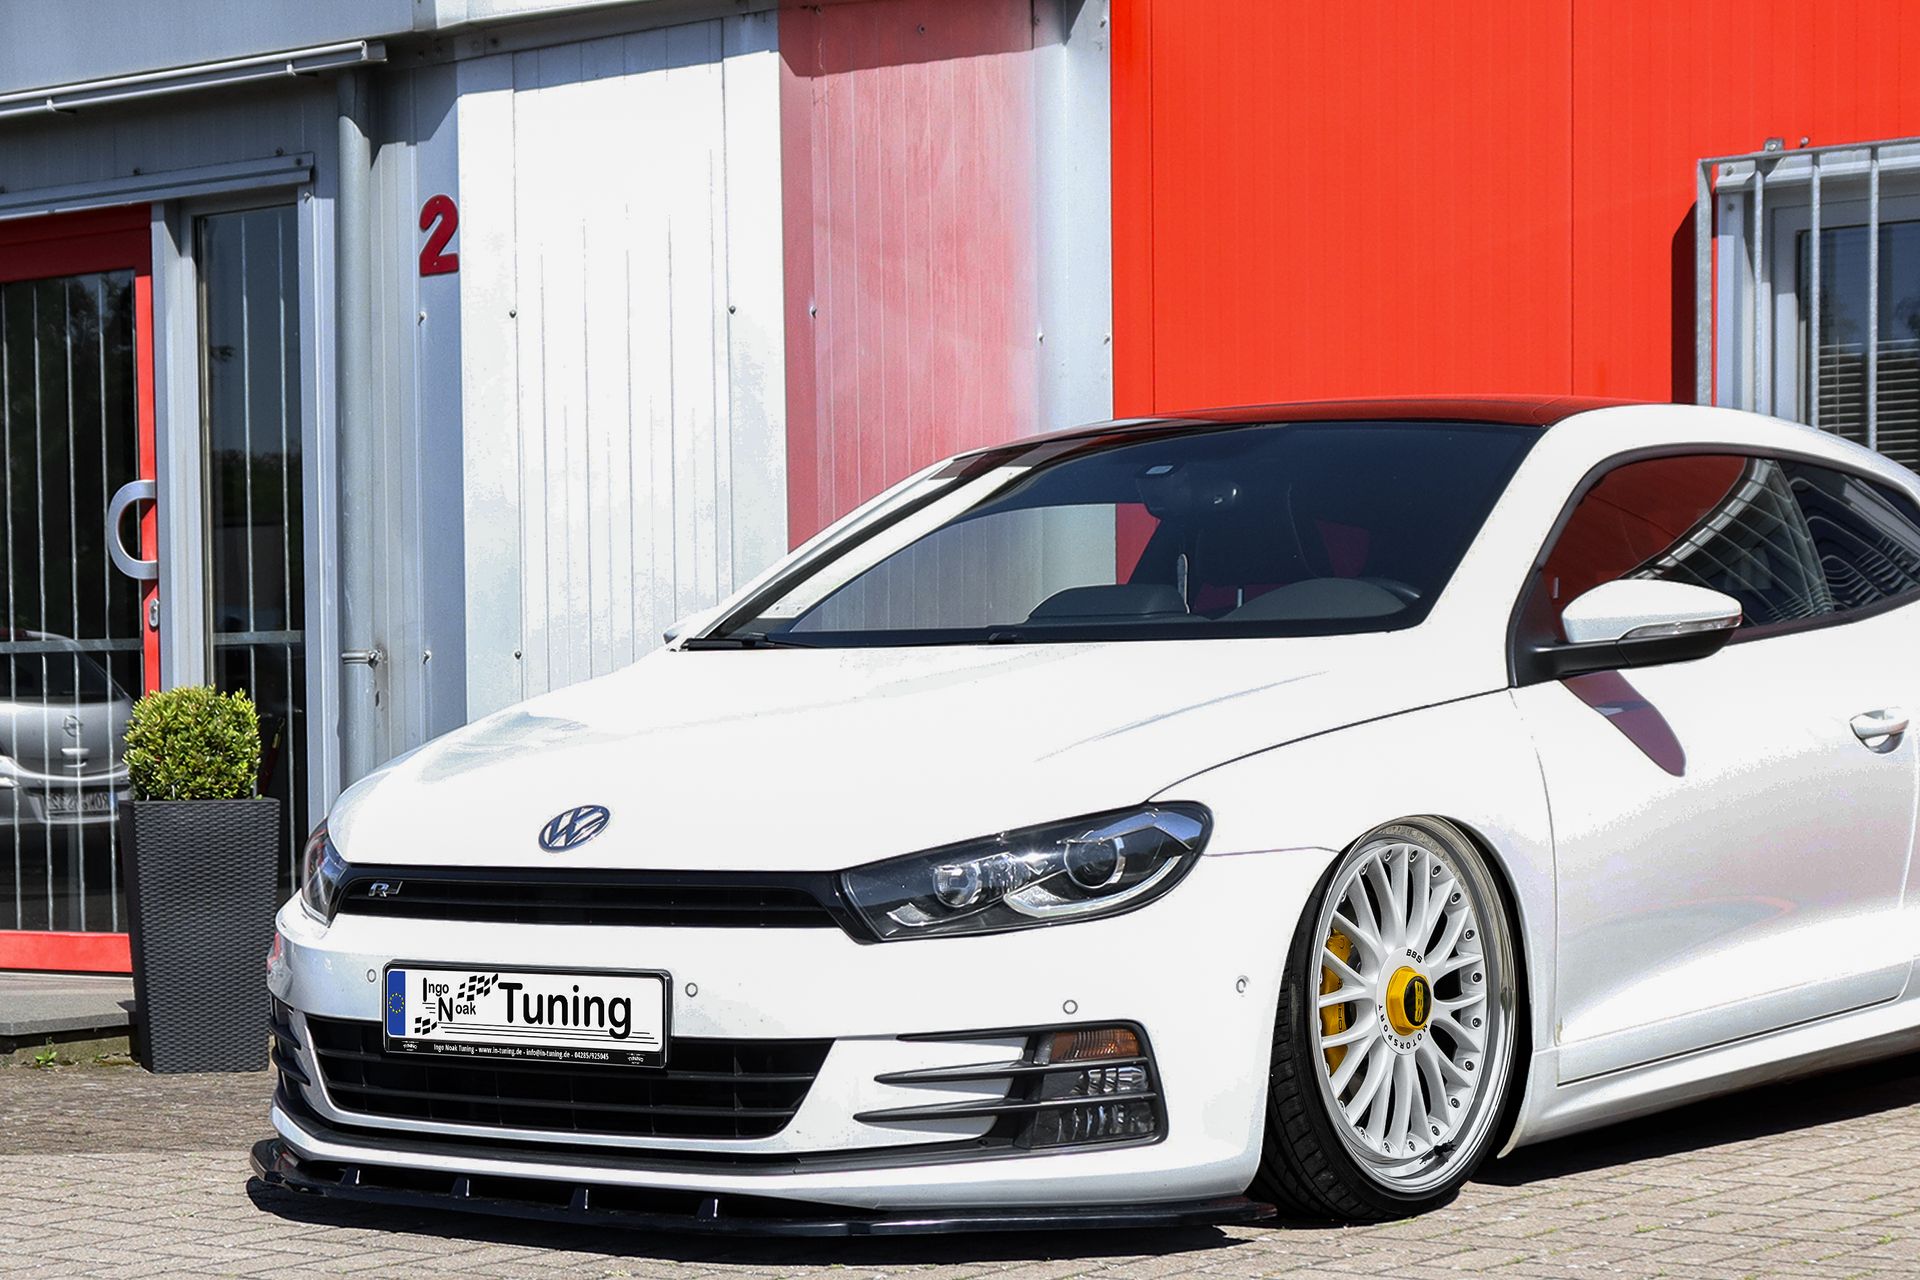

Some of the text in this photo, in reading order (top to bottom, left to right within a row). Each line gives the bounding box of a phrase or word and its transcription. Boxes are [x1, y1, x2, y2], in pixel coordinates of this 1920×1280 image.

[419, 194, 459, 278] 2
[1406, 949, 1423, 964] BBS
[423, 977, 449, 1002] Ingo
[1415, 980, 1424, 1022] BBS
[438, 997, 476, 1022] Noak
[498, 982, 631, 1039] Tuning
[1378, 1004, 1429, 1050] MOTORSPORT
[433, 1043, 445, 1053] Ingo
[445, 1044, 458, 1052] Noak
[458, 1044, 475, 1055] Tuning
[478, 1046, 523, 1057] www.in-tuning.de
